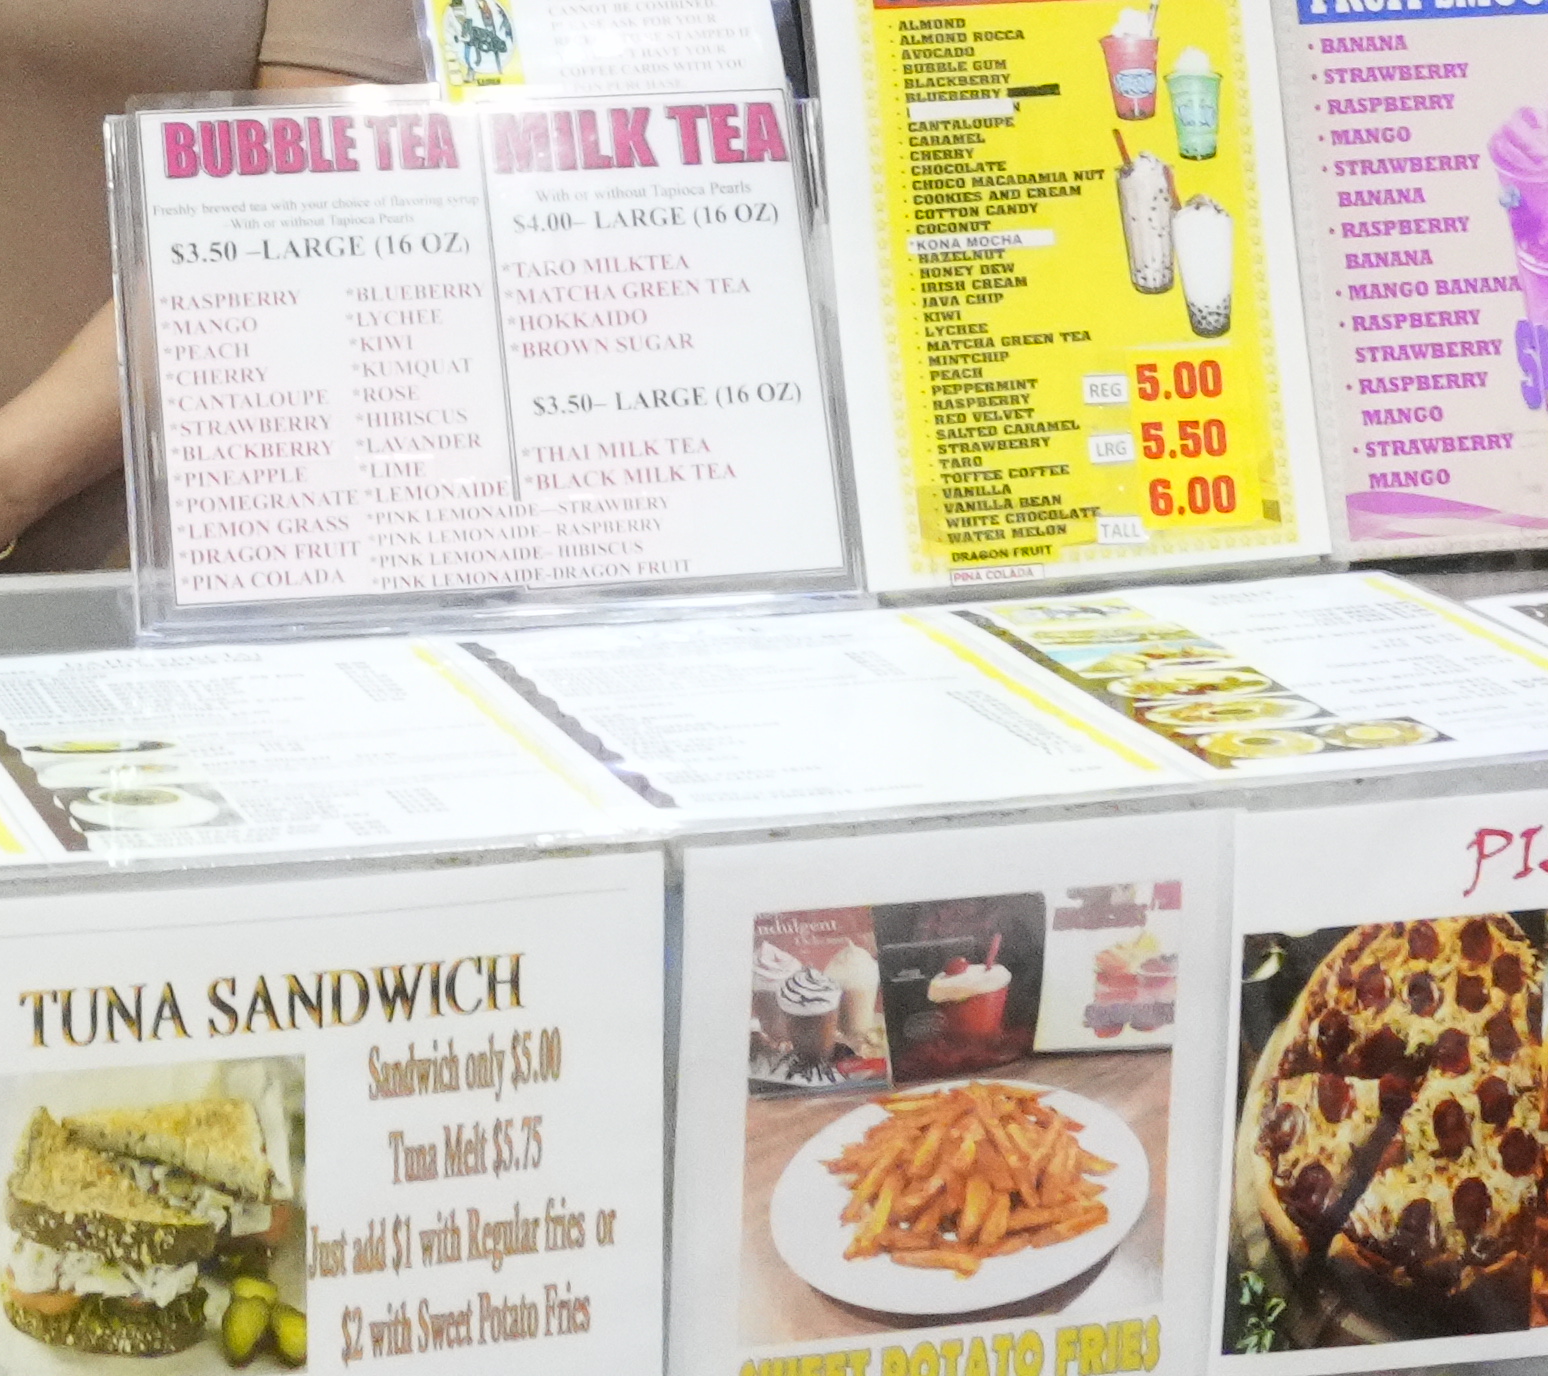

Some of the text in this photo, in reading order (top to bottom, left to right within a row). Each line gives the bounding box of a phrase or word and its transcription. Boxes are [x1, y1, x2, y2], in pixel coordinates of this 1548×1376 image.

[899, 18, 965, 30] ALMOND
[1321, 35, 1407, 54] BANANA
[165, 114, 459, 178] BUBBLE TEA
[489, 103, 787, 176] MILK TEA
[170, 239, 238, 266] $3.50
[374, 235, 413, 259] (16
[422, 232, 470, 257] OZ)
[1089, 376, 1123, 401] REG
[1136, 360, 1222, 401] 5.00
[1095, 438, 1127, 460] LRG
[1141, 419, 1227, 459] 5.50
[1149, 475, 1236, 516] 6.00
[1100, 520, 1143, 542] TALL
[20, 955, 521, 1046] TUNA SANDWICH
[368, 1027, 561, 1101] Sandwich only $5.00
[389, 1116, 542, 1185] Tuna Melt $5.75
[1054, 1315, 1162, 1376] FRIES
